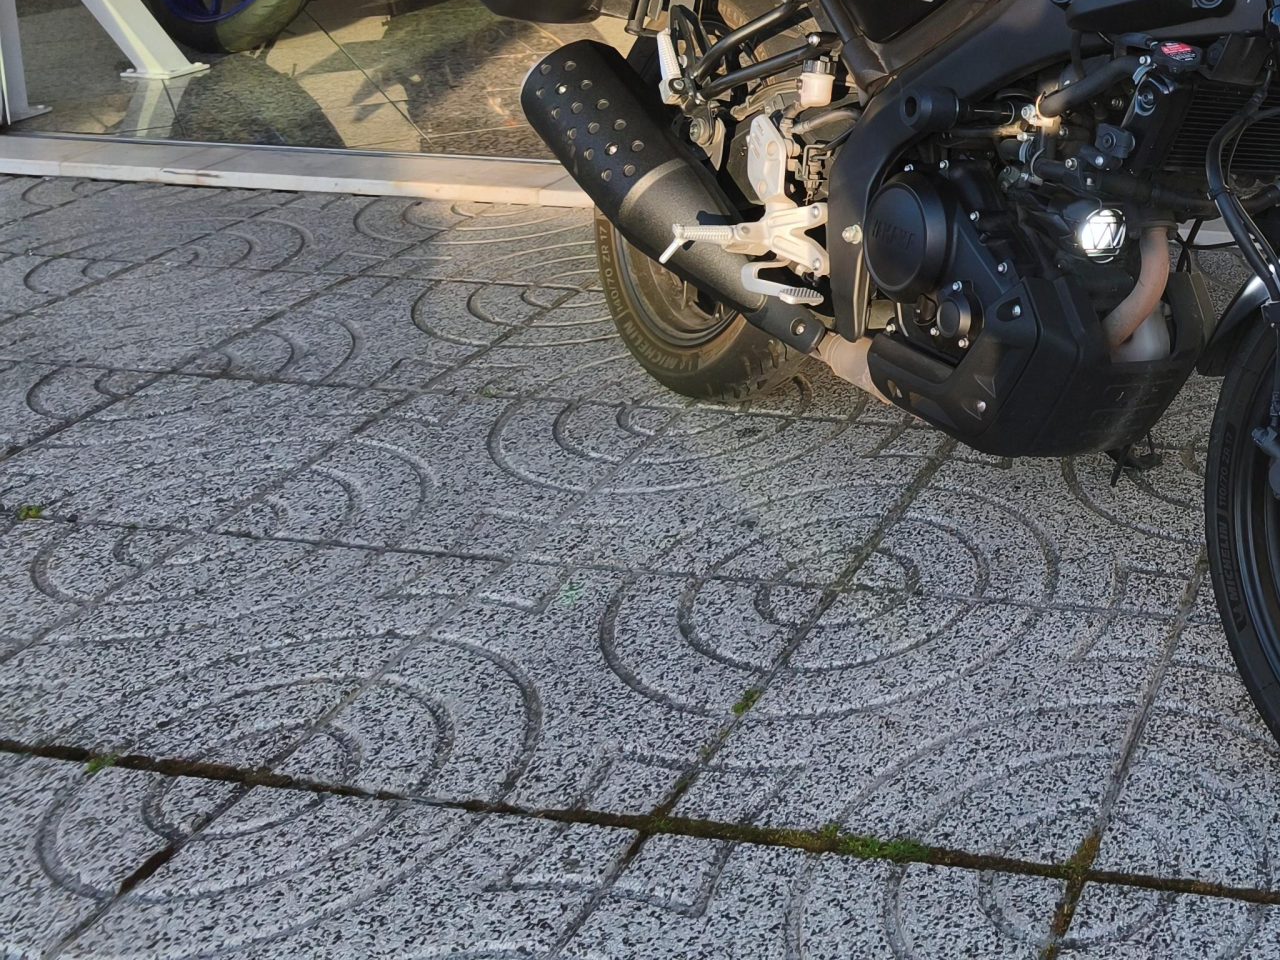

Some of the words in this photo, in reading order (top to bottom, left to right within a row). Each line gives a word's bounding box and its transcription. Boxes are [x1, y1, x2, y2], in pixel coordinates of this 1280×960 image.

[602, 245, 611, 262] ZR
[623, 320, 678, 369] MICHELIN
[1219, 521, 1240, 601] MICHELIN
